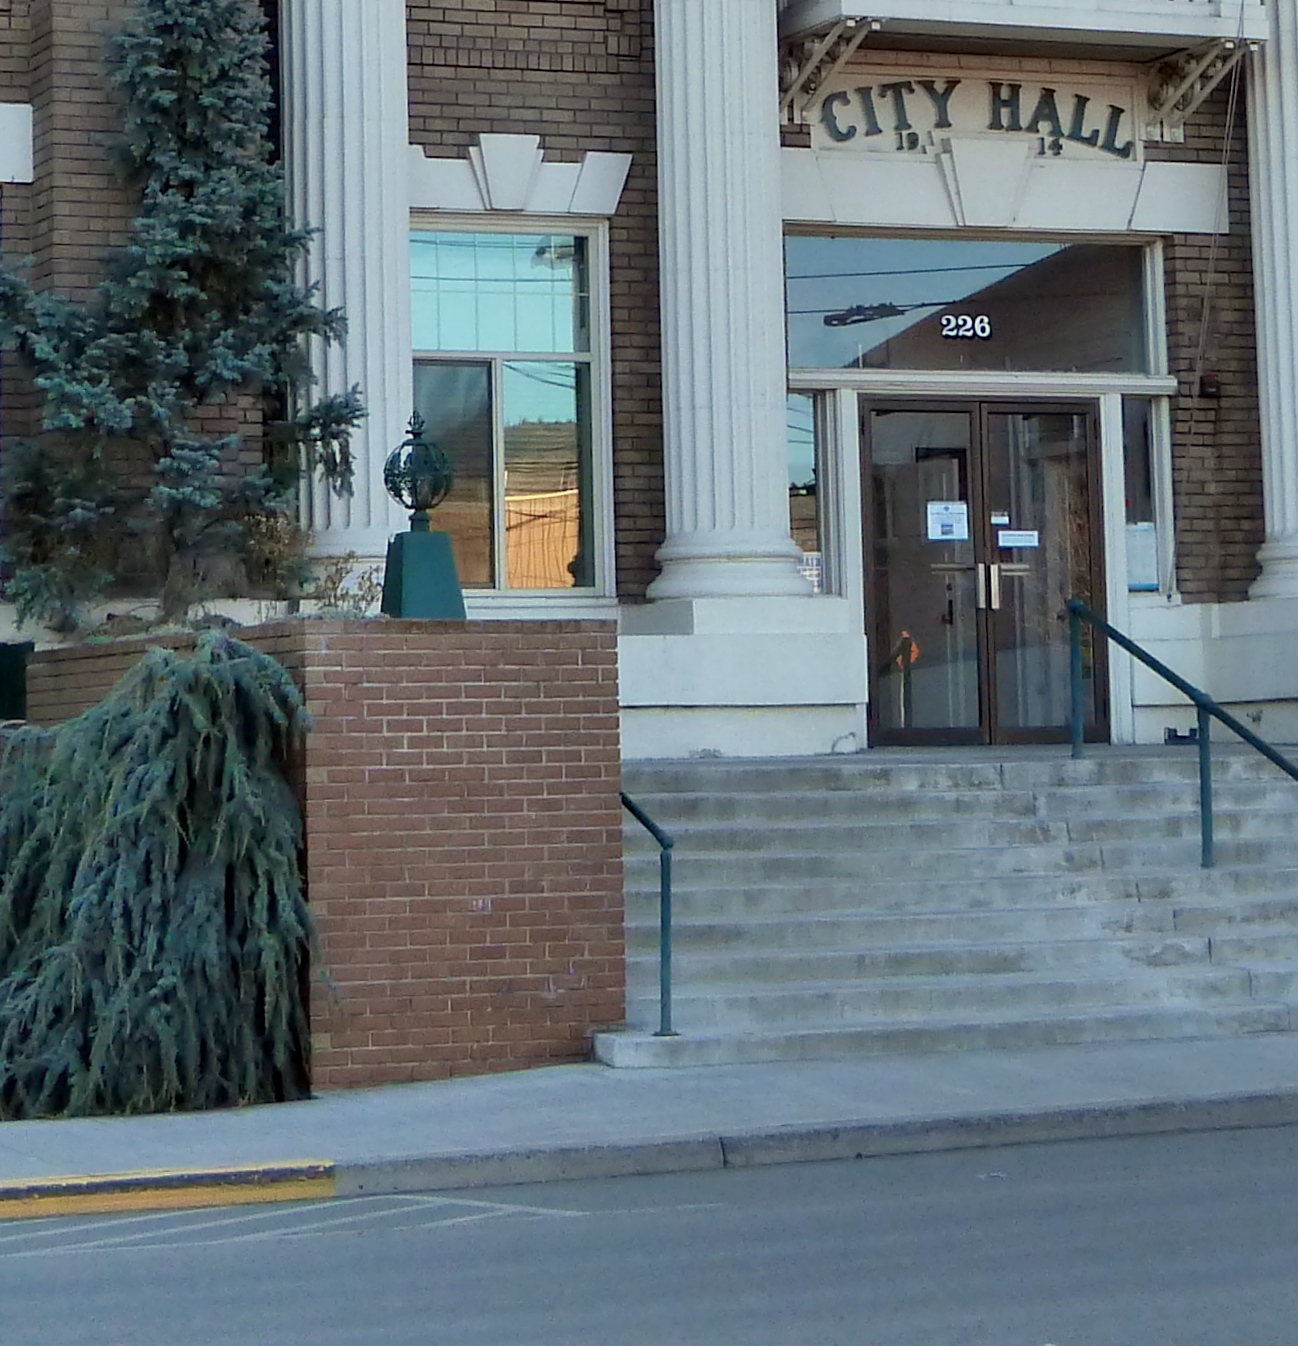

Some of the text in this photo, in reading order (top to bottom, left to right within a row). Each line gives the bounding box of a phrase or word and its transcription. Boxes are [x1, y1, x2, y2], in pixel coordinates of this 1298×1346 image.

[820, 80, 1134, 158] CITY HALL
[1037, 137, 1063, 156] 14
[940, 314, 991, 338] 226
